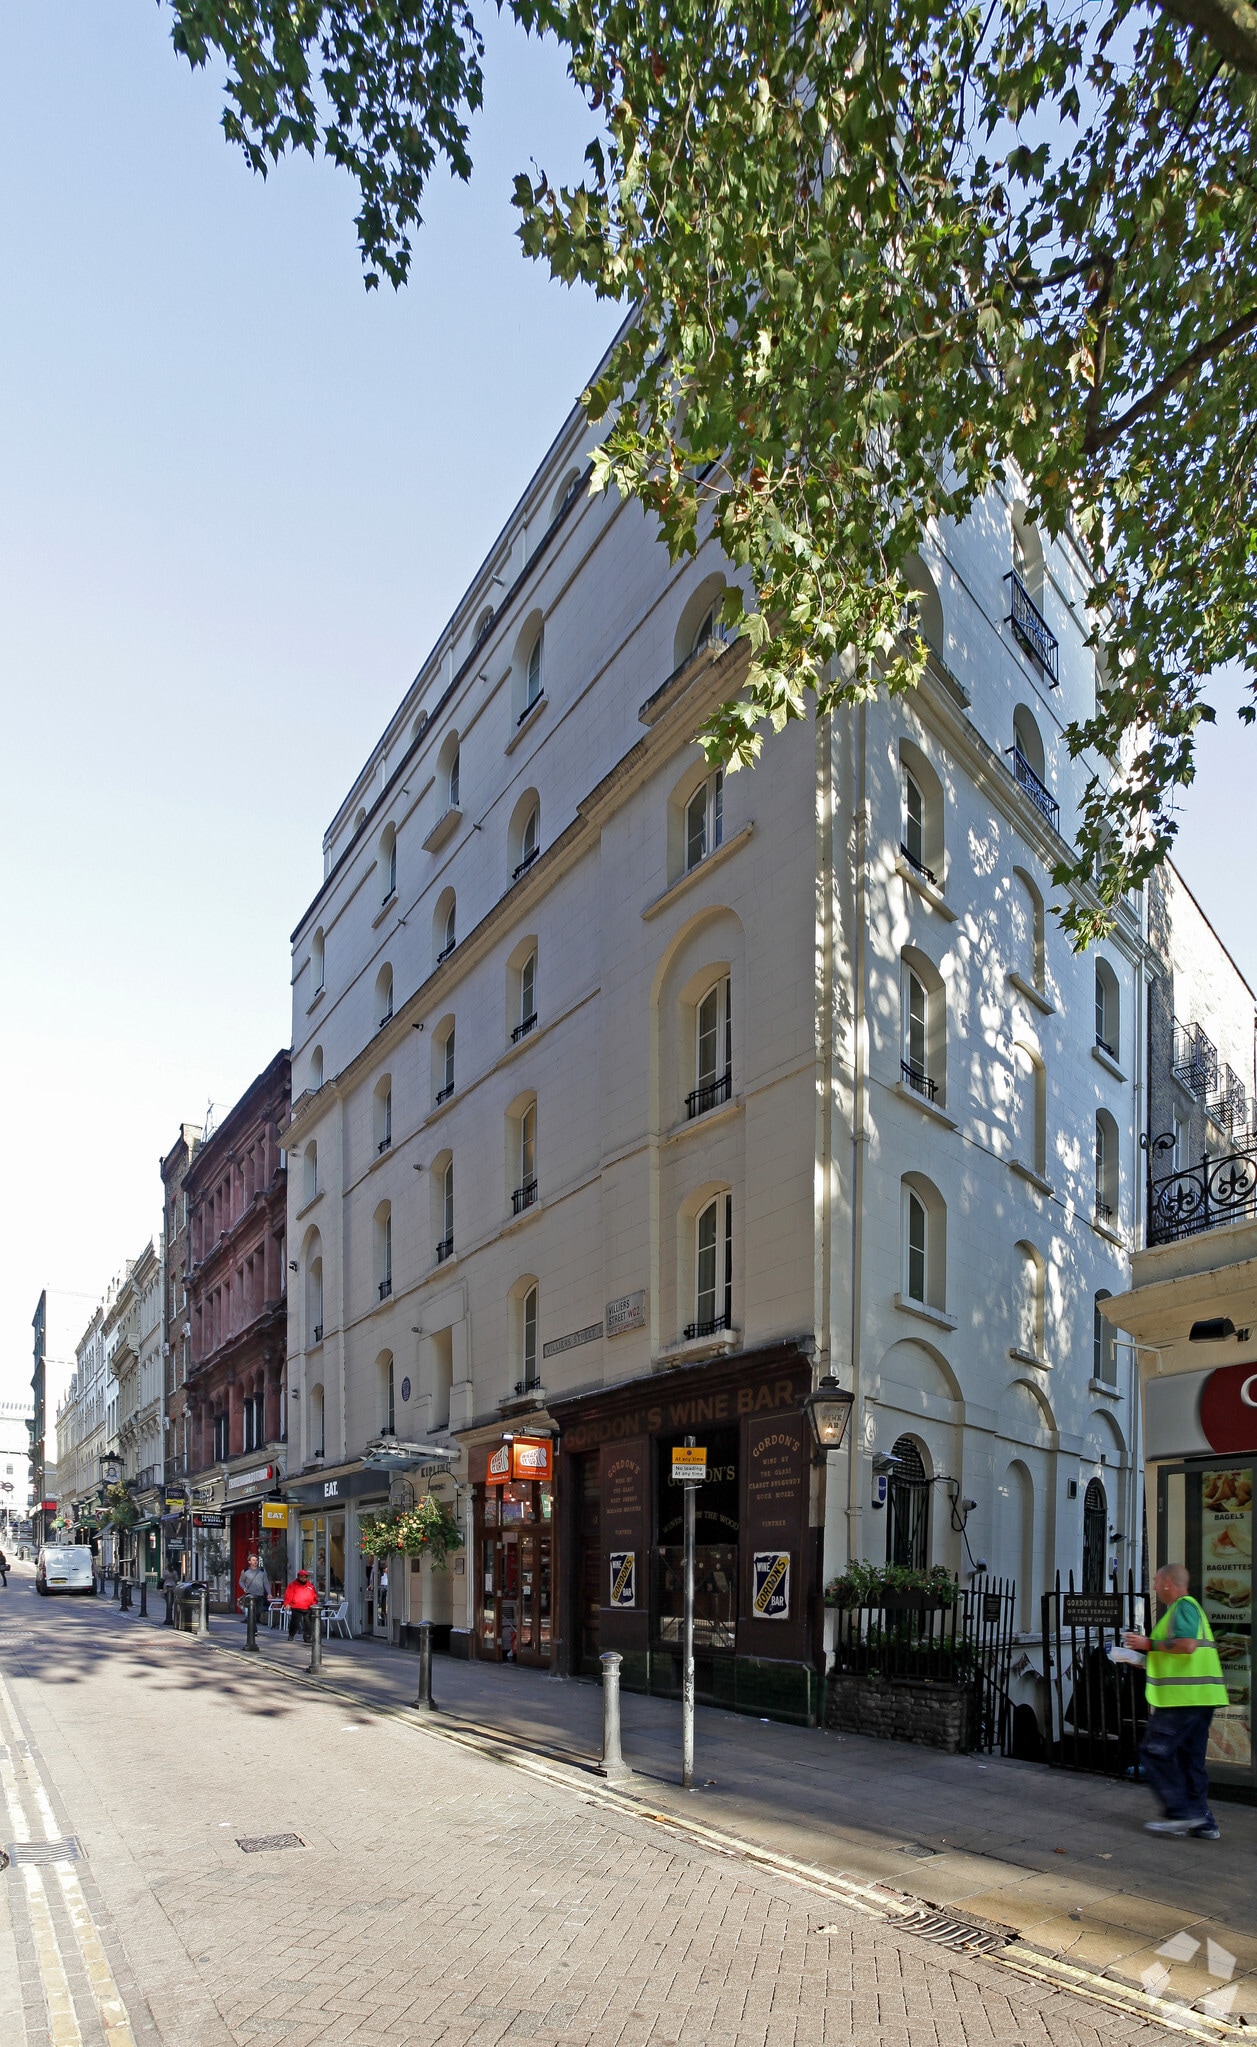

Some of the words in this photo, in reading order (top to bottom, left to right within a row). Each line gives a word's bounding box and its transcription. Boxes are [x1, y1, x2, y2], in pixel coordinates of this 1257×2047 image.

[609, 1300, 630, 1314] VILLIERS
[609, 1311, 627, 1325] STREET
[628, 1306, 640, 1318] WC2
[547, 1339, 571, 1354] VILLIERS
[565, 1408, 661, 1448] GORDON'S
[671, 1395, 729, 1426] WINE
[737, 1380, 793, 1413] BAR
[752, 1434, 800, 1458] GORDON'S
[607, 1460, 640, 1478] GORDON'S
[684, 1465, 703, 1473] loading
[324, 1480, 339, 1498] EAT.
[267, 1511, 285, 1520] EAT.
[704, 1510, 719, 1521] THE
[719, 1513, 740, 1532] WOOD
[1214, 1512, 1245, 1521] BAGELS
[756, 1562, 771, 1573] WINE
[1206, 1563, 1252, 1571] BAGUETTES
[756, 1559, 786, 1609] GORDON'S
[622, 1587, 633, 1597] BAR
[771, 1596, 784, 1606] BAR
[1066, 1599, 1098, 1607] GORDON'S
